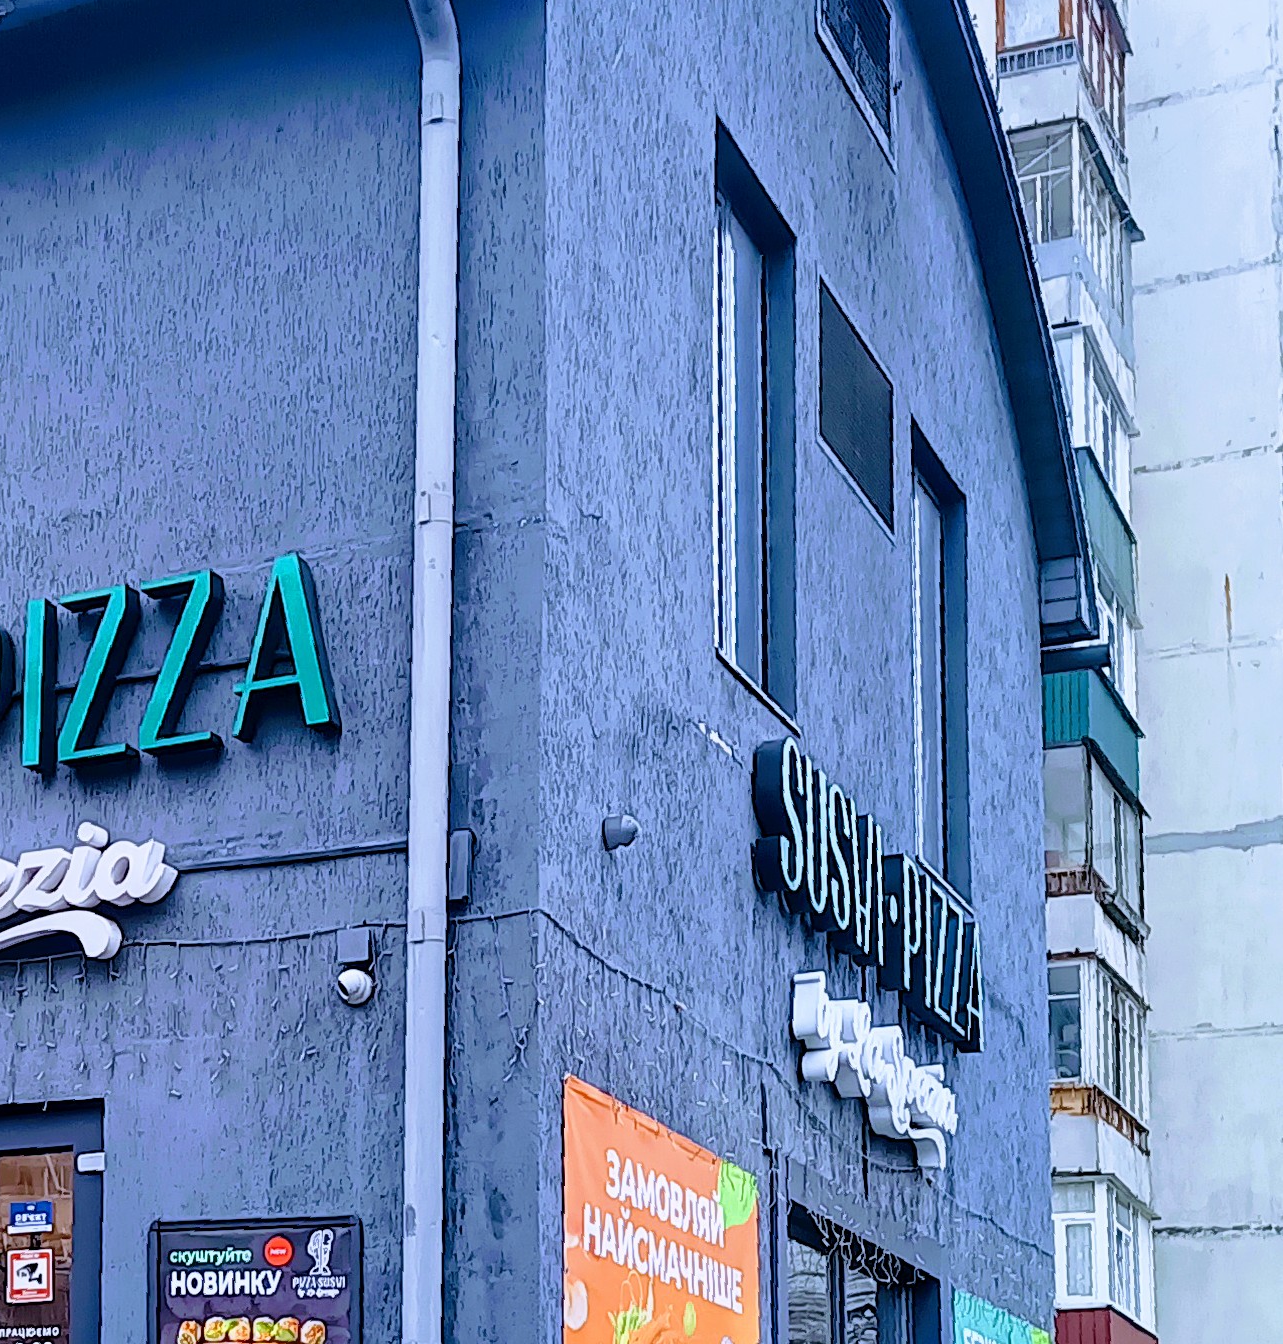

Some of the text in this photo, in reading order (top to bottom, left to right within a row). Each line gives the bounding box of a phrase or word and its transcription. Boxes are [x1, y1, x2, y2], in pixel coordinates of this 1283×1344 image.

[776, 736, 986, 1053] SUSHI PIZZA
[605, 1149, 725, 1248] ЗАМОВЛЯЙ
[169, 1246, 252, 1266] скуштуйте
[170, 1269, 282, 1296] НОВИНКУ
[583, 1202, 743, 1314] НАЙСМАЧНІШЕ
